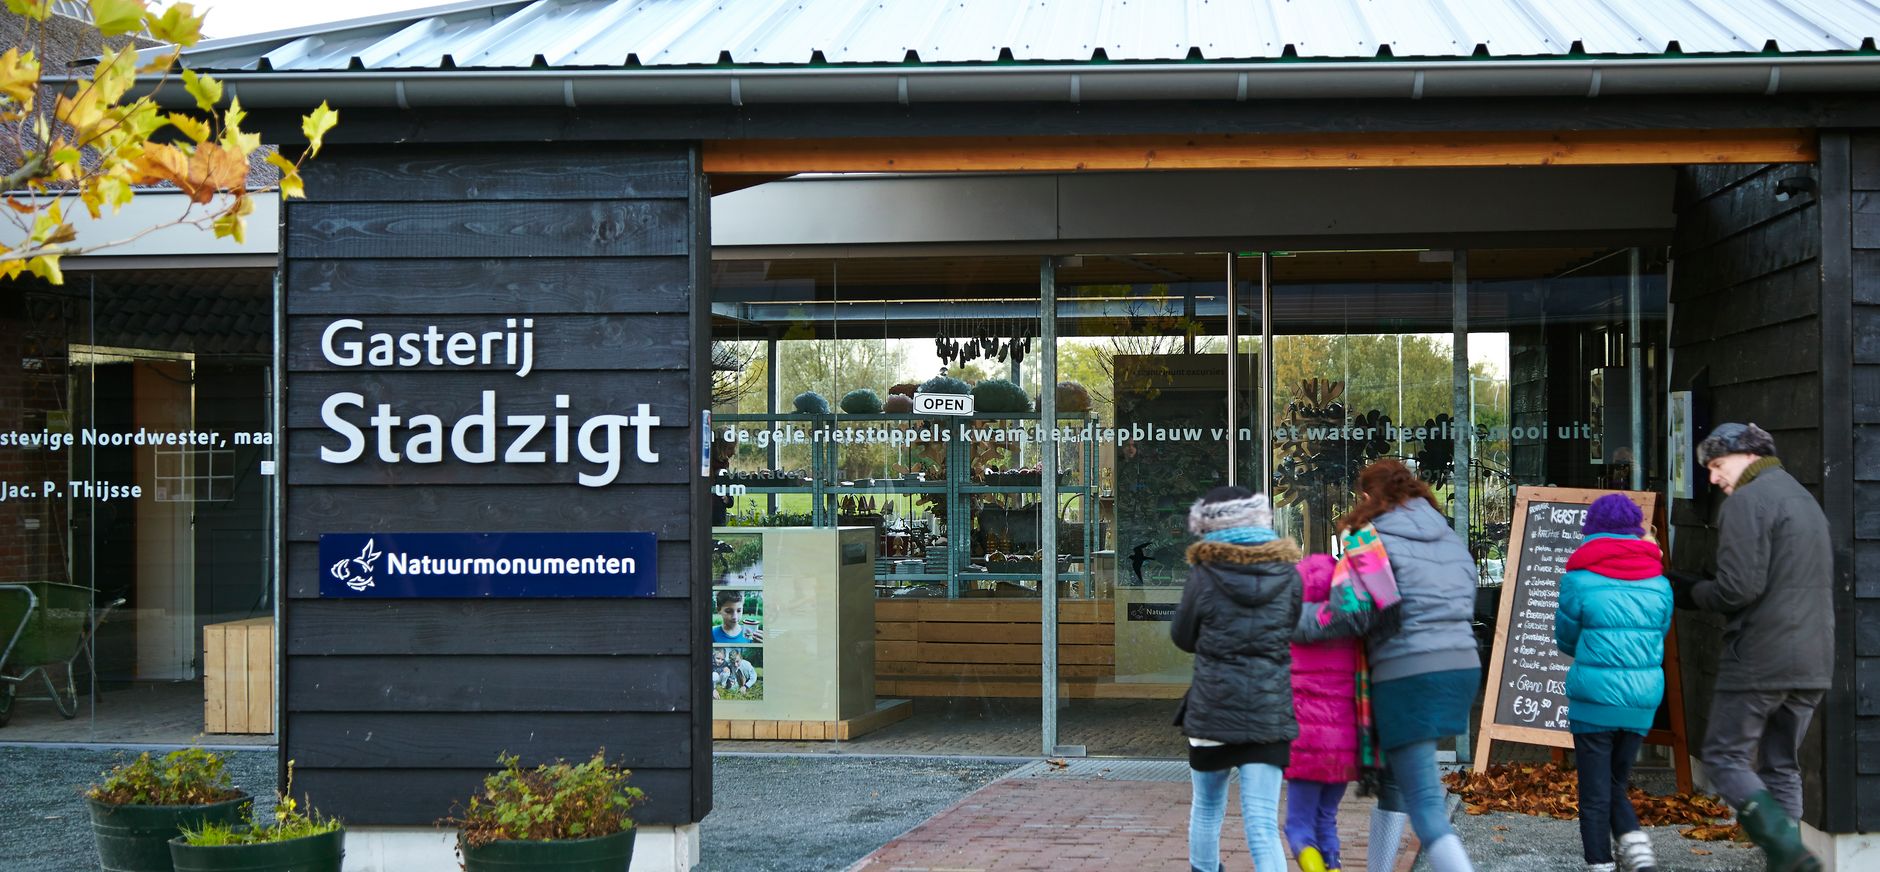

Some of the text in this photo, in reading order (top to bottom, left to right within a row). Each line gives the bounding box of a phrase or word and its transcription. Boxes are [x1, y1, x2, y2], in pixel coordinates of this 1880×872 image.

[321, 318, 534, 377] Gasterij
[924, 398, 964, 411] OPEN
[0, 429, 74, 450] stevige
[82, 428, 227, 447] Noordwester,
[320, 390, 660, 487] Stadzigt
[723, 424, 750, 442] de
[757, 424, 806, 448] gele
[813, 424, 951, 448] rietstoppels
[960, 424, 1026, 442] kwam
[1081, 423, 1203, 447] diepblauw
[1307, 426, 1376, 442] water
[1489, 421, 1548, 441] mooi
[0, 481, 142, 502] Jac. P. Thijsse
[1550, 506, 1580, 525] KERST
[386, 552, 636, 577] Natuurmonumenten
